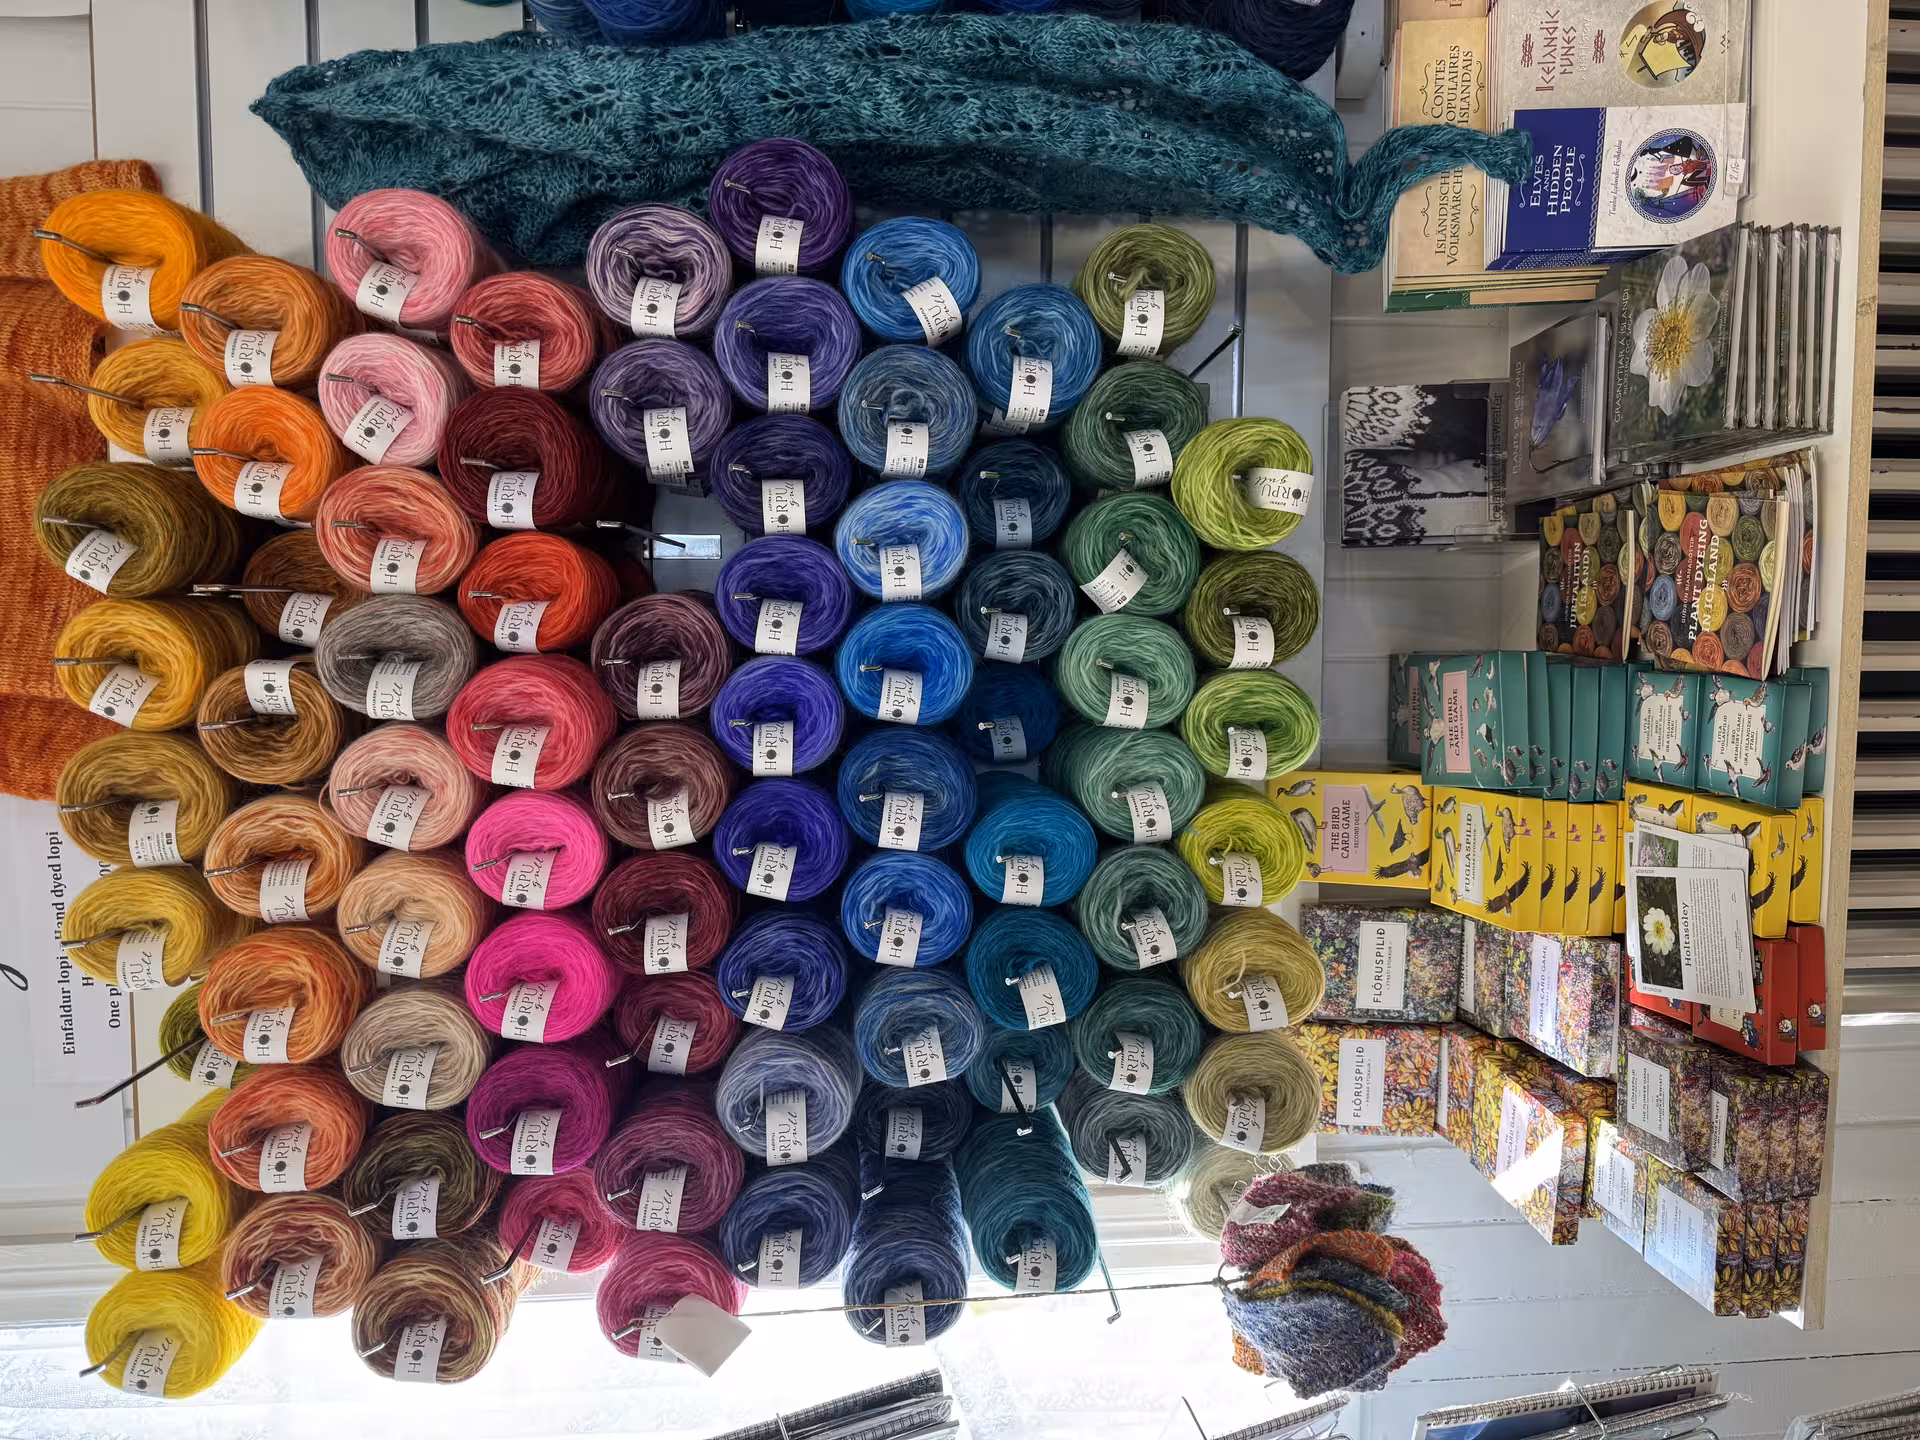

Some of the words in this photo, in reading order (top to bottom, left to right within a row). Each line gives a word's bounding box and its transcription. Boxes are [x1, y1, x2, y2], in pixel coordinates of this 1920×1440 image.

[1430, 58, 1448, 119] CONTES
[1457, 50, 1474, 124] ISLANDAIS
[1612, 139, 1624, 167] Folktales
[1530, 154, 1545, 207] ELVES
[1543, 168, 1552, 192] AND
[1546, 144, 1564, 216] HIDDEN
[1560, 146, 1577, 214] PEOPLE
[1608, 196, 1619, 216] Twelve
[1609, 168, 1621, 194] Icelandic
[1446, 166, 1464, 266] VOLKSMÄRCHE
[1618, 287, 1630, 334] ÍSLANDI
[1514, 360, 1522, 412] ICELAND
[1614, 350, 1626, 423] GRASNYTJAR
[1491, 392, 1504, 440] sweater
[1512, 432, 1520, 474] PLANTS
[1490, 469, 1502, 522] Icelandic
[1694, 518, 1708, 582] DYEING
[1704, 534, 1720, 609] ICELAND
[1570, 542, 1581, 629] JURTALITUN
[1578, 549, 1590, 607] ÍSLANDI
[1688, 584, 1702, 640] PLANT
[1701, 612, 1712, 632] IN
[1332, 806, 1341, 830] BIRD
[1342, 799, 1351, 830] GAME
[46, 831, 62, 859] lopi
[1331, 832, 1340, 851] THE
[1341, 832, 1350, 859] CARD
[48, 863, 66, 898] dyed
[1681, 902, 1692, 966] Holtasóley
[56, 955, 74, 984] lopi
[1372, 928, 1386, 1003] FLÓRUSPILIÐ
[58, 987, 76, 1055] Einfaldur
[108, 1000, 122, 1029] One
[1352, 1046, 1364, 1118] FLÓRUSPILIÐ
